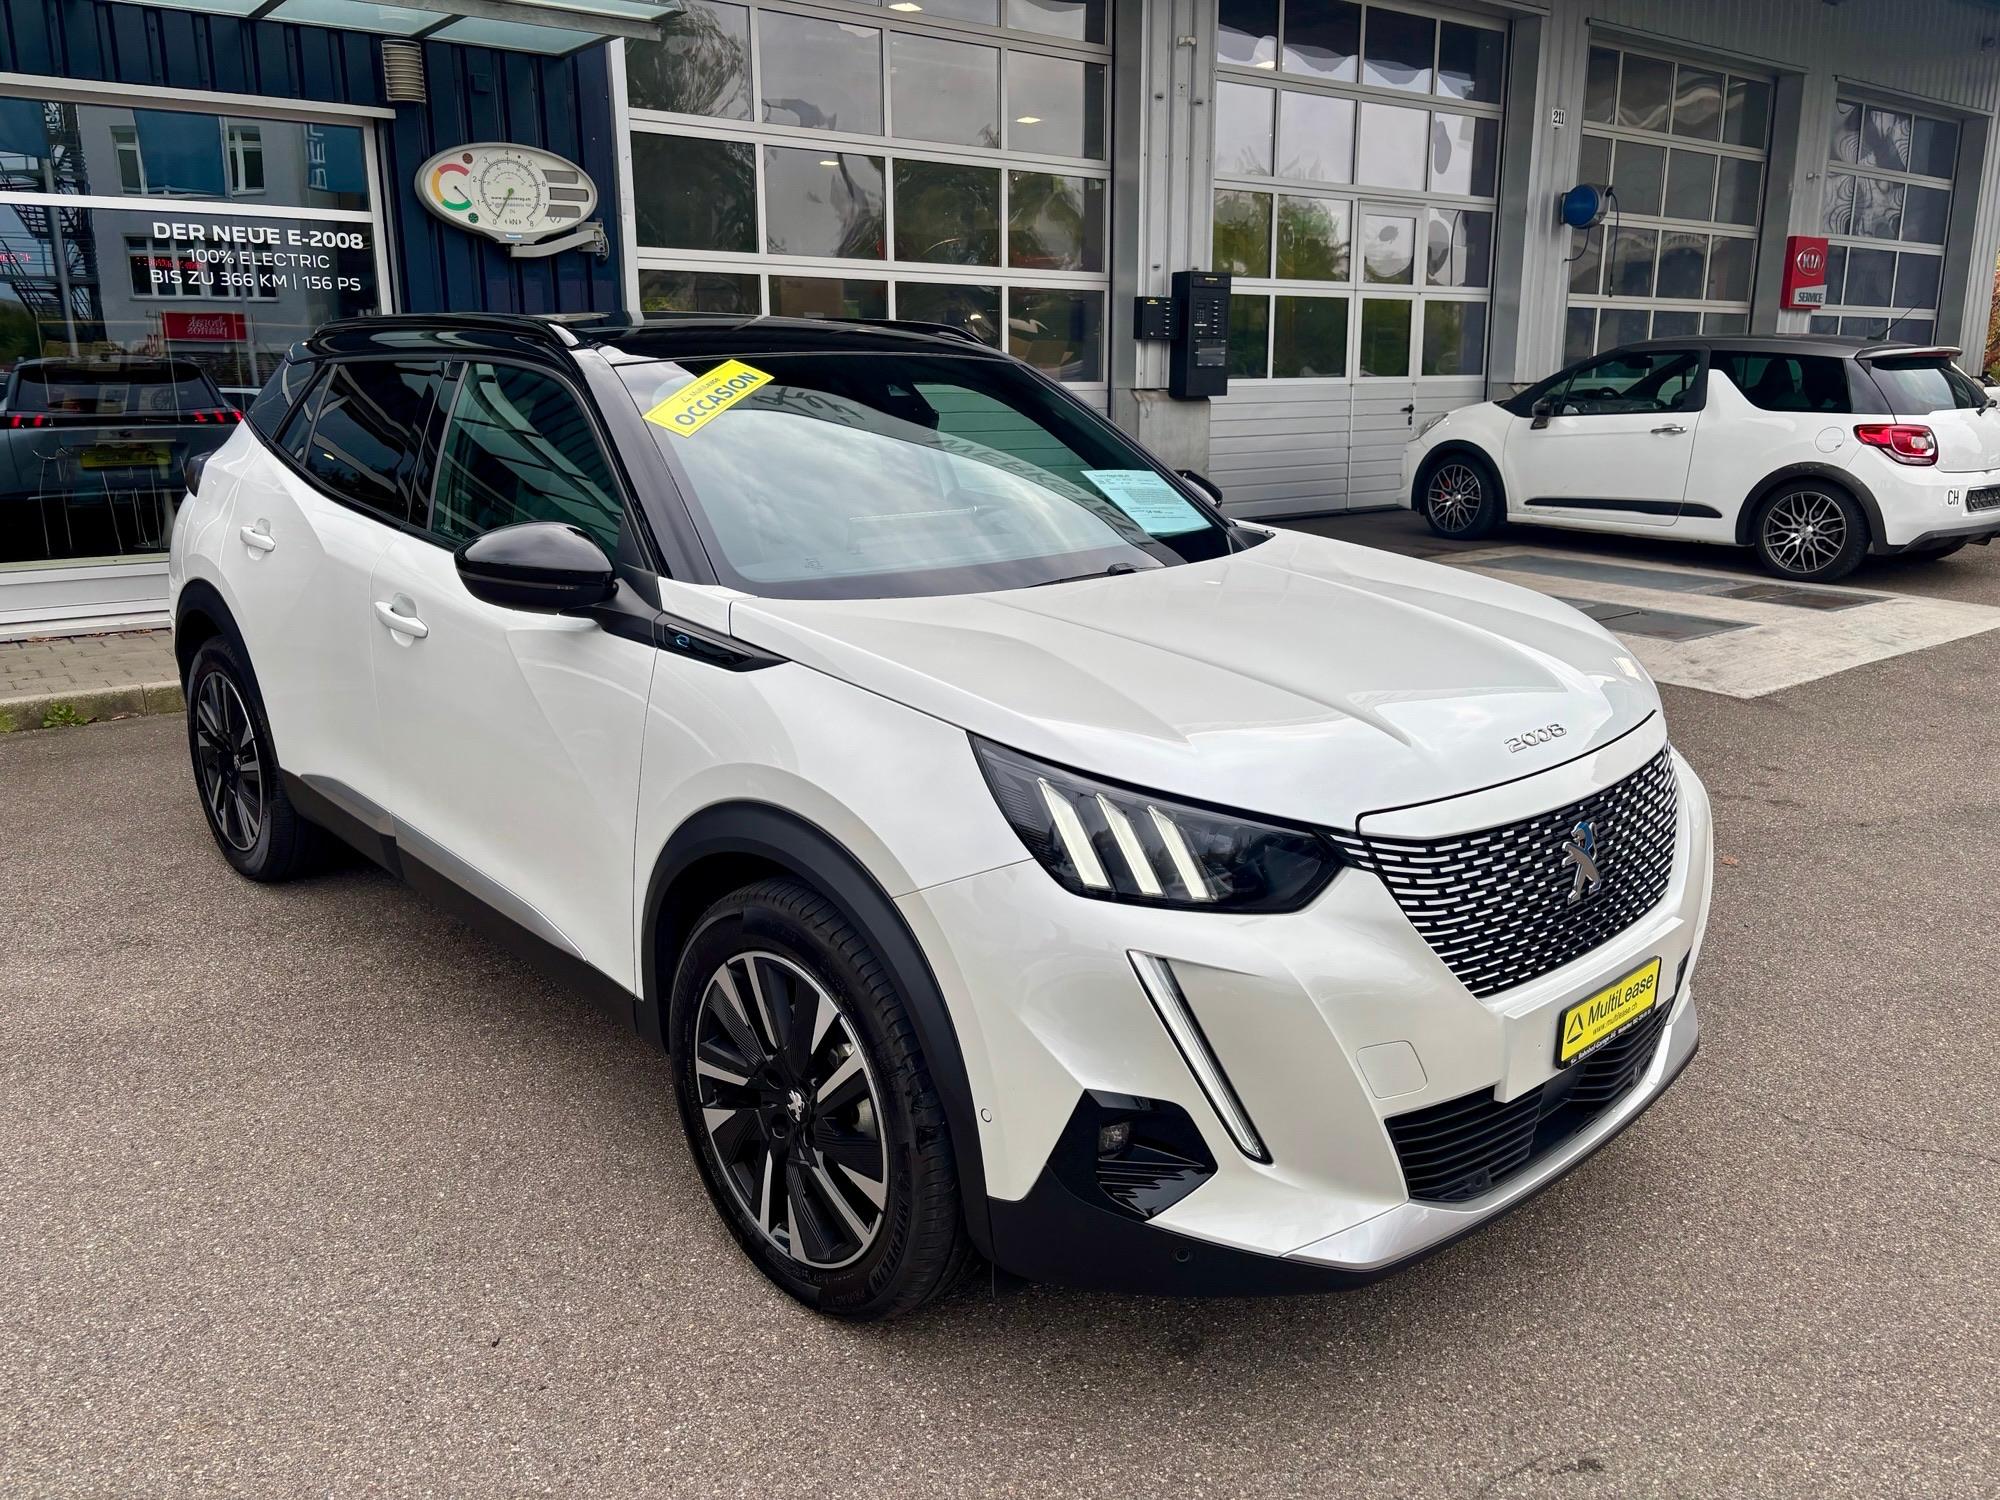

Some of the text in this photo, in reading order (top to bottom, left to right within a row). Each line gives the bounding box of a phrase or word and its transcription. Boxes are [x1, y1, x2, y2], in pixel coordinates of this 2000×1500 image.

[1552, 110, 1565, 125] 211
[152, 222, 364, 249] DER NEUE E-2008
[186, 249, 234, 264] 100%
[239, 252, 330, 269] ELECTRIC
[150, 269, 182, 284] BIS
[188, 271, 215, 286] ZU
[220, 272, 254, 287] 366
[260, 273, 287, 288] KM
[302, 275, 333, 290] 156
[337, 277, 362, 292] PS
[1798, 292, 1824, 303] SERVICE
[674, 371, 761, 426] OCCASION
[1947, 489, 1960, 506] CH
[1504, 723, 1568, 754] 2008
[1587, 973, 1654, 1027] MultiLease
